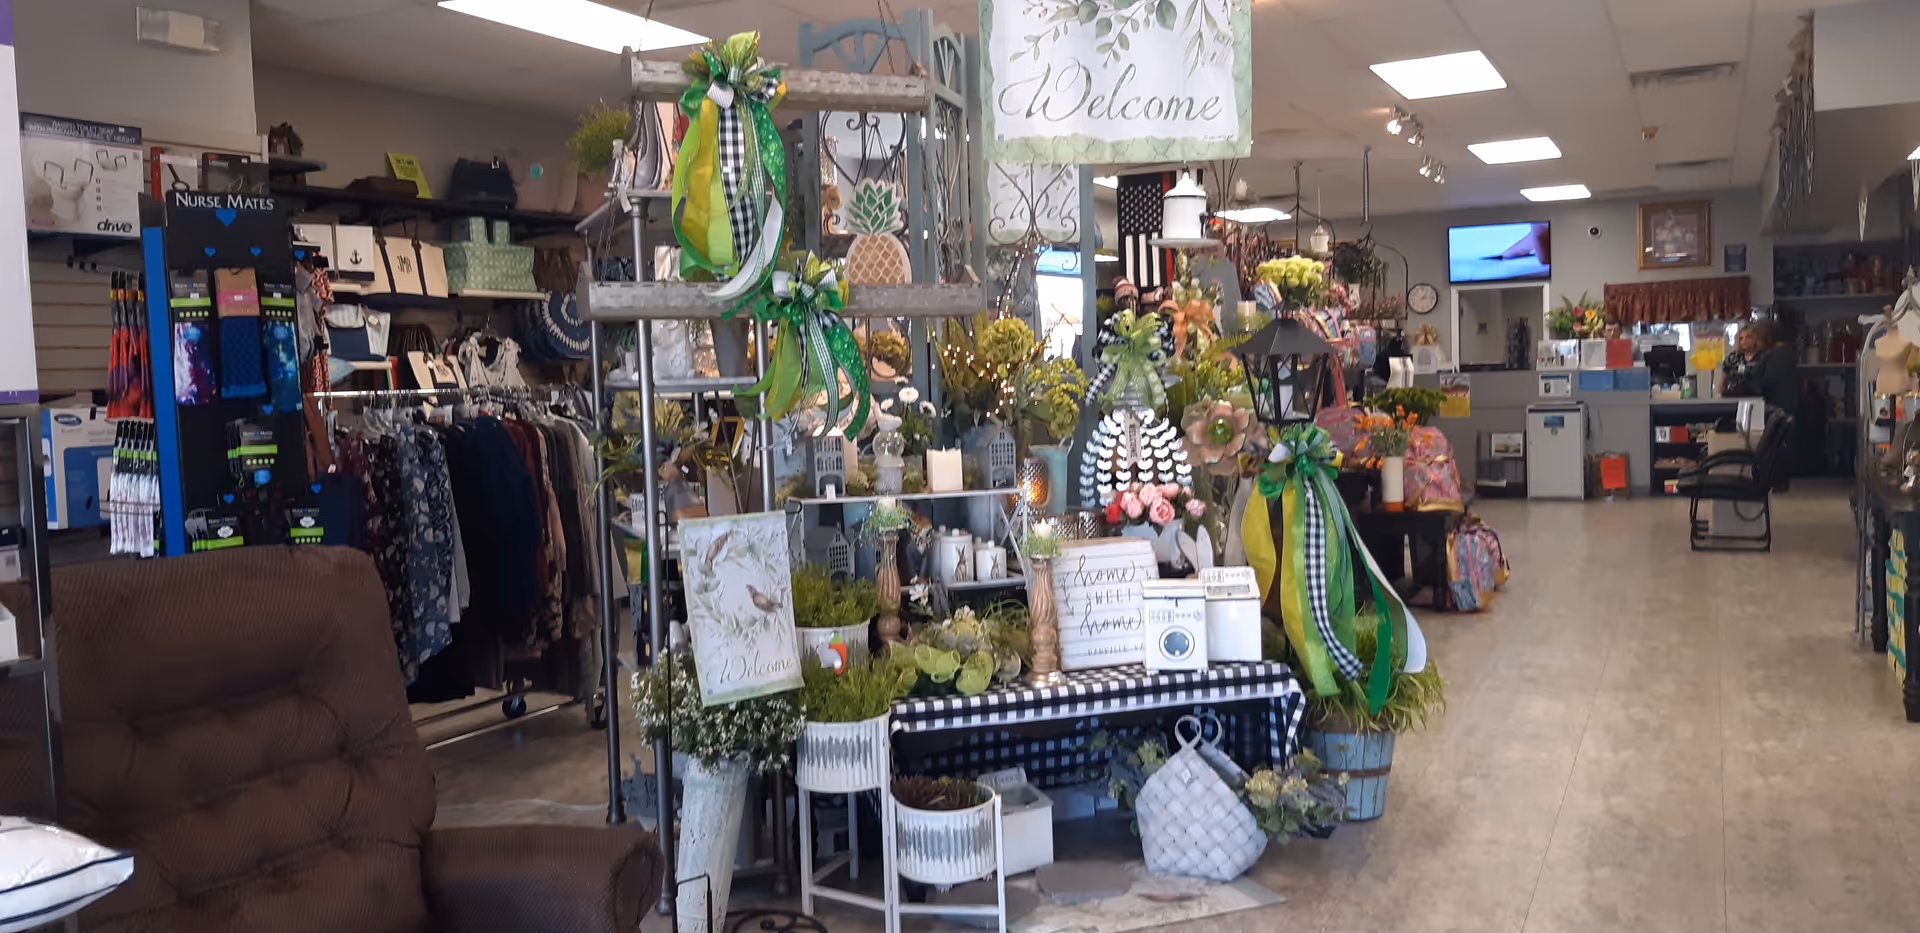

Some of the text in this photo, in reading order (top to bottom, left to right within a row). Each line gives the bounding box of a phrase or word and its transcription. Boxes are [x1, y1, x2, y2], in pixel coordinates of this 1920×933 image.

[998, 57, 1223, 122] Welcome
[175, 192, 275, 211] NURSE MATES
[96, 218, 133, 233] drive
[1073, 554, 1136, 588] home
[1086, 588, 1132, 605] SWEET
[1080, 603, 1142, 637] home
[705, 649, 793, 685] Welcome
